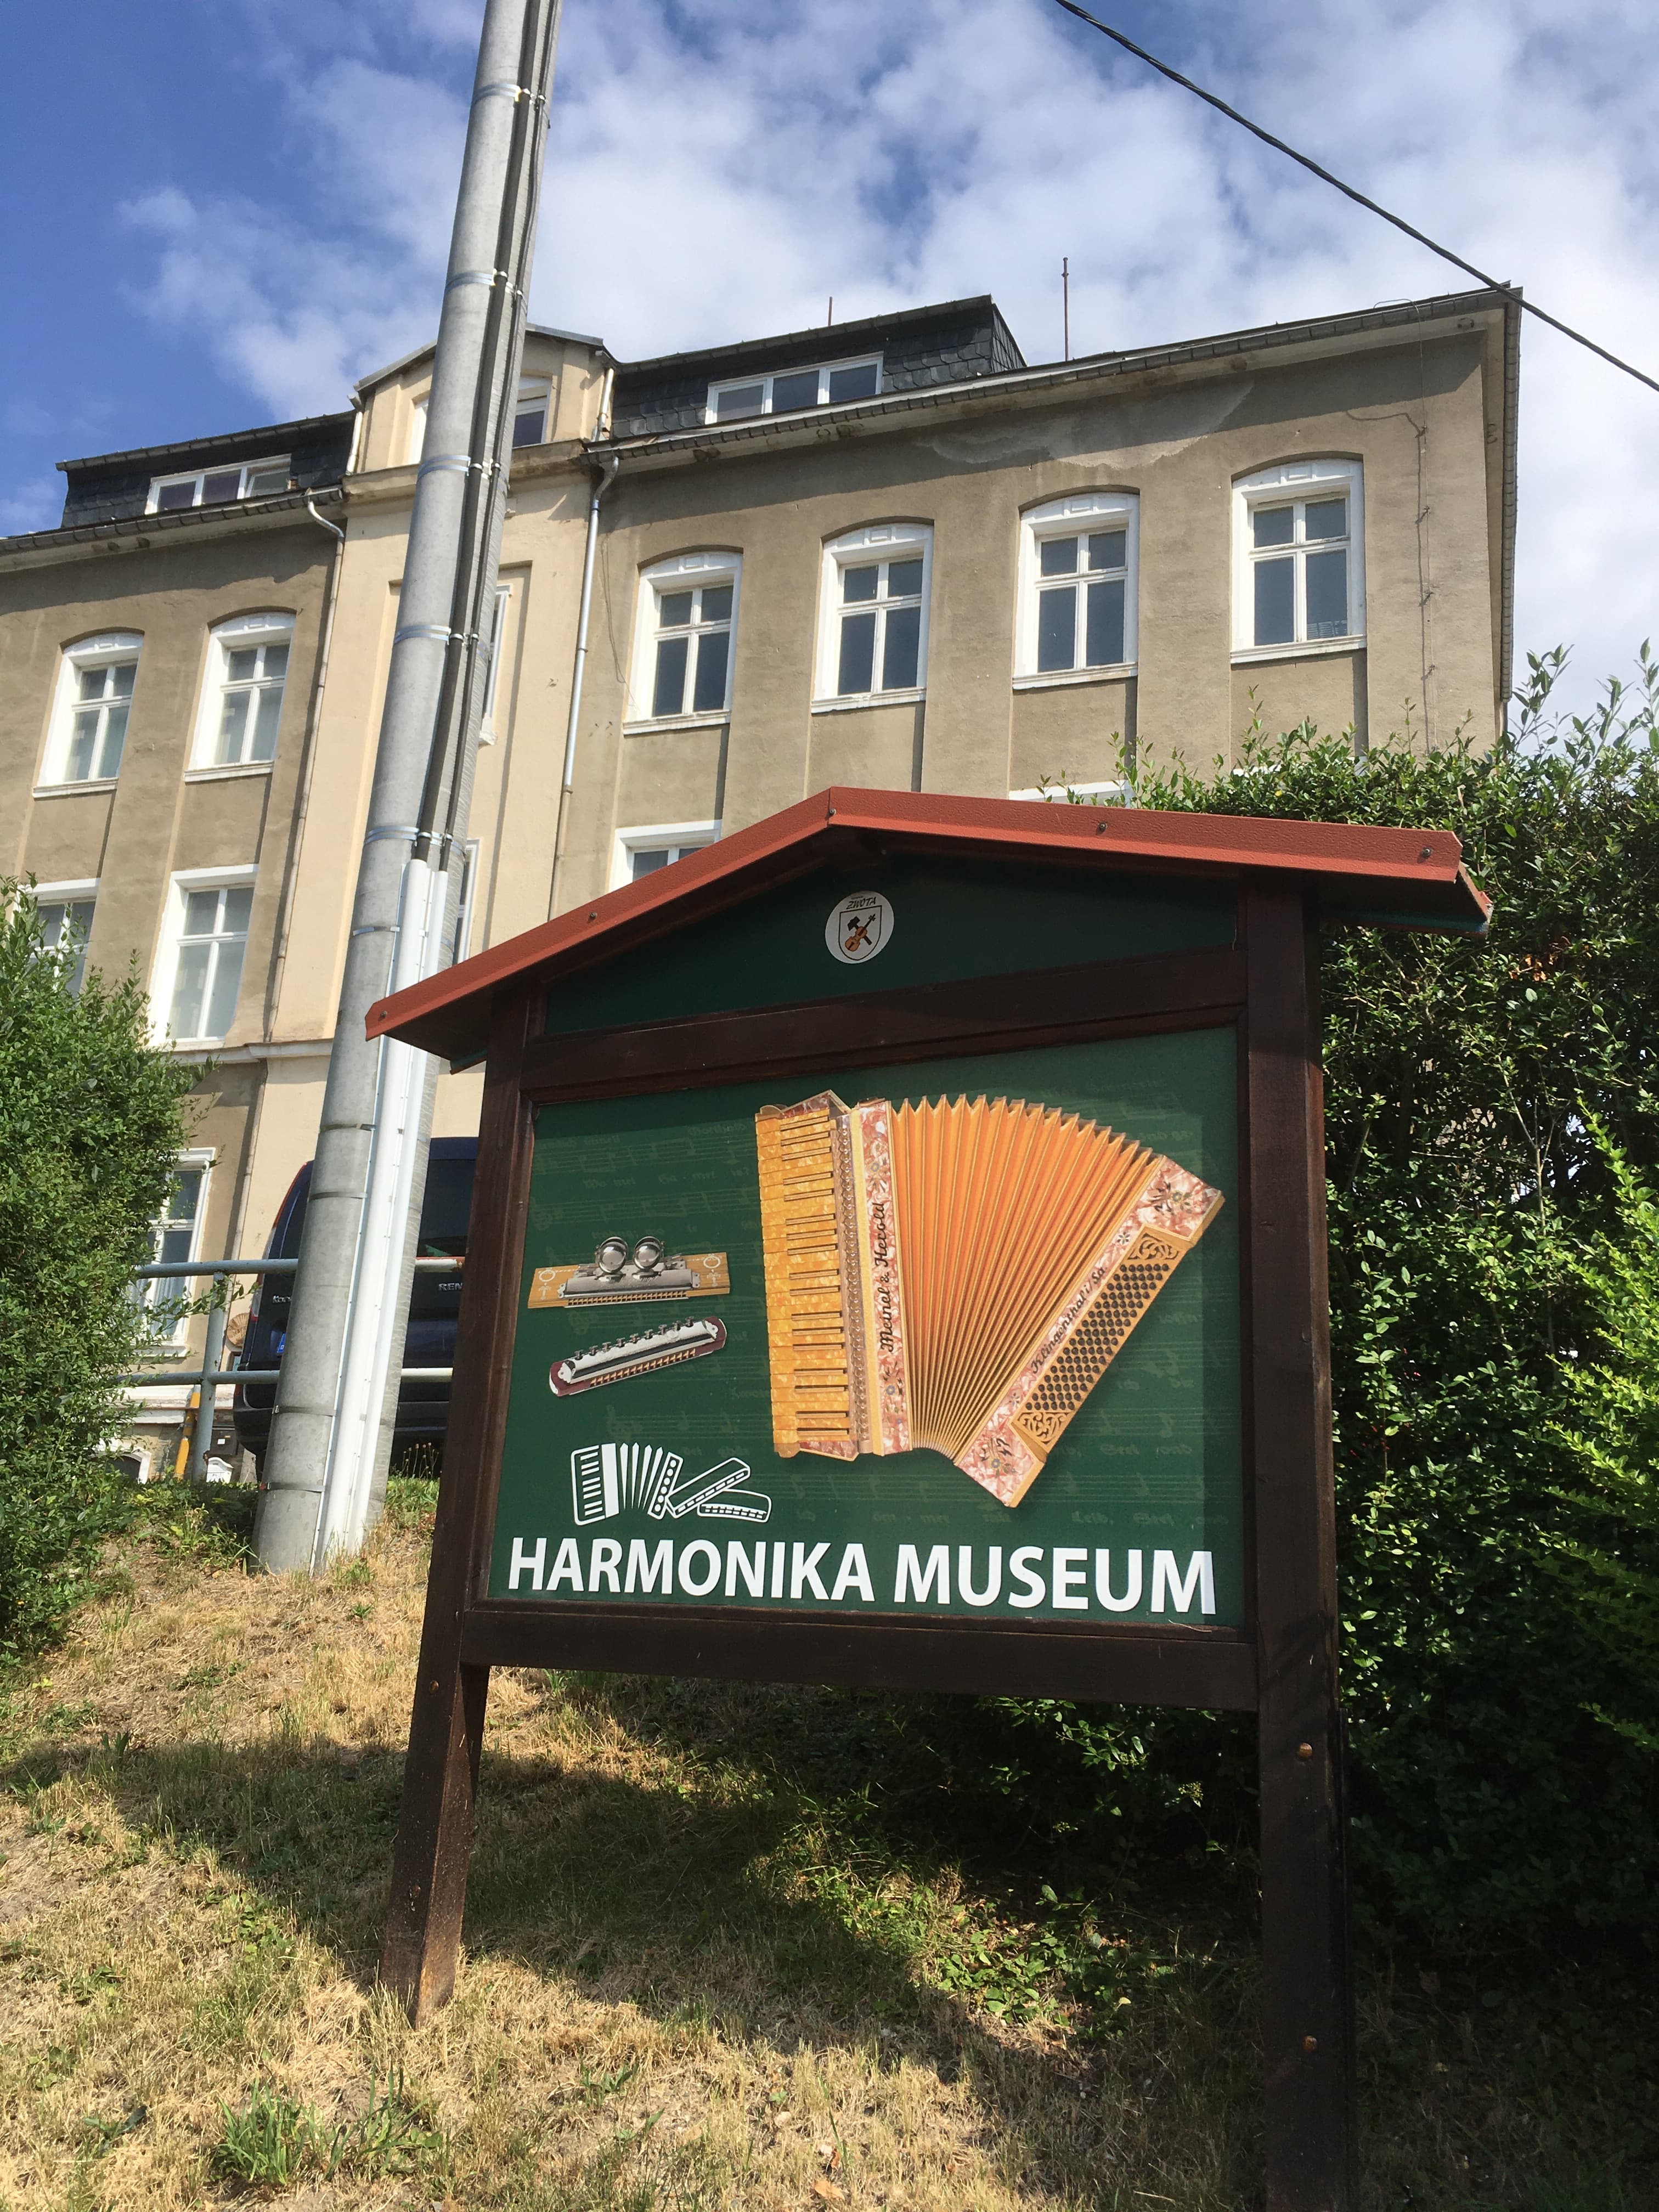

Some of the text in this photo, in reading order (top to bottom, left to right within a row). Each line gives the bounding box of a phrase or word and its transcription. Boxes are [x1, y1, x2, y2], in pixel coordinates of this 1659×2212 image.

[846, 896, 877, 910] ZWOTA
[872, 1202, 894, 1352] Meinel & Herold
[1031, 1289, 1087, 1374] Klingenthal
[509, 1537, 1216, 1615] HARMONIKA MUSEUM
